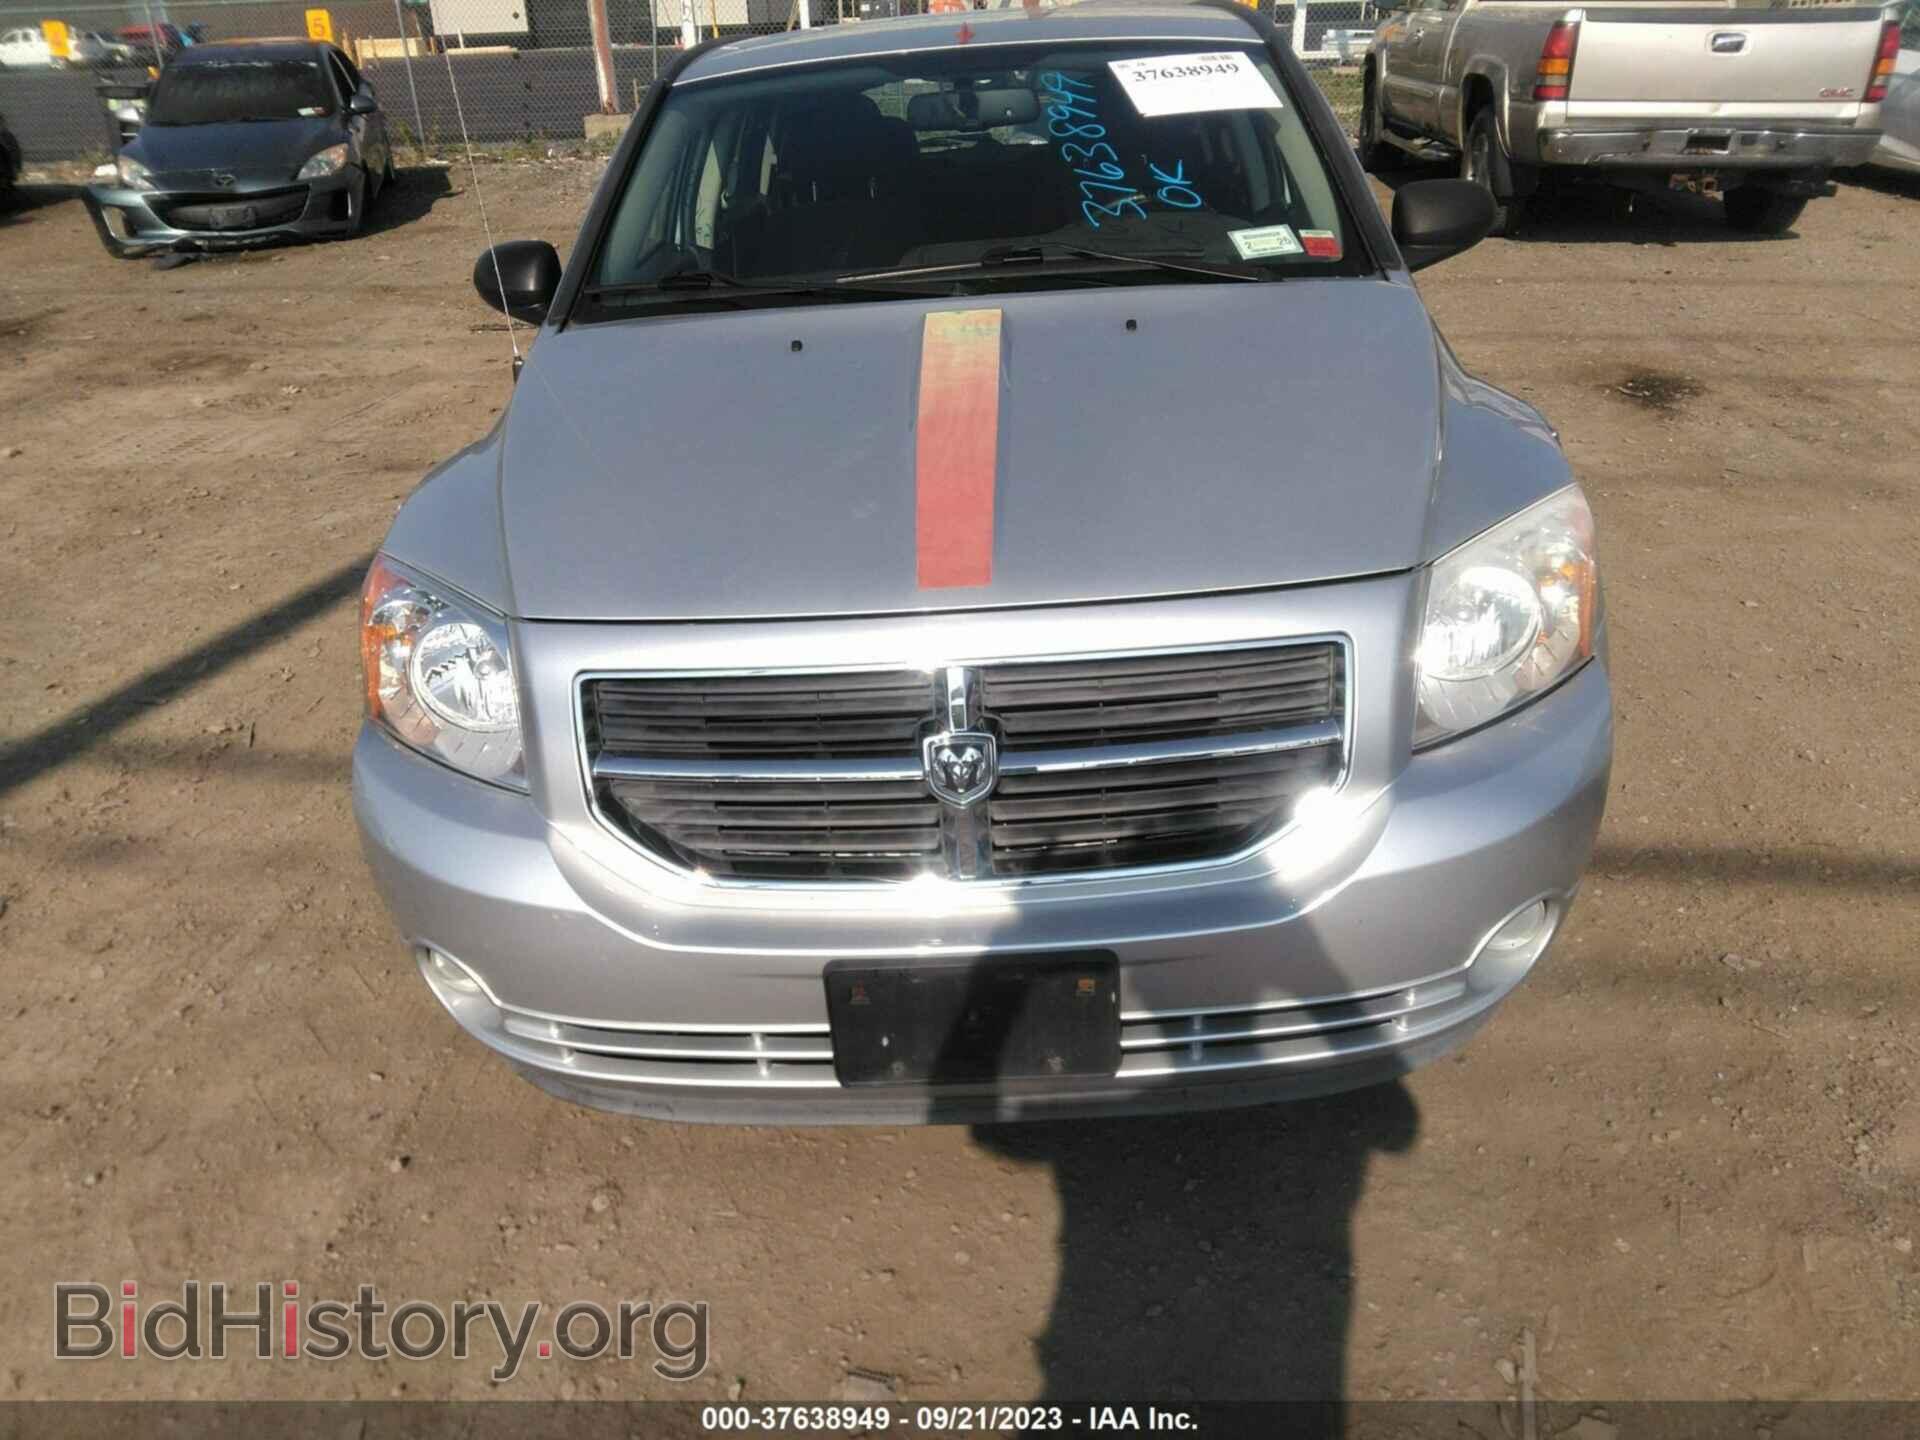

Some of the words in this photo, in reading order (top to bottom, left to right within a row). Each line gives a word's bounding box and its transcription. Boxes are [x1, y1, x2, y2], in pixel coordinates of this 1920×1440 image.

[311, 18, 326, 37] 5
[1132, 62, 1240, 83] 37638949
[1041, 72, 1146, 227] 37638949
[1150, 159, 1201, 207] OK
